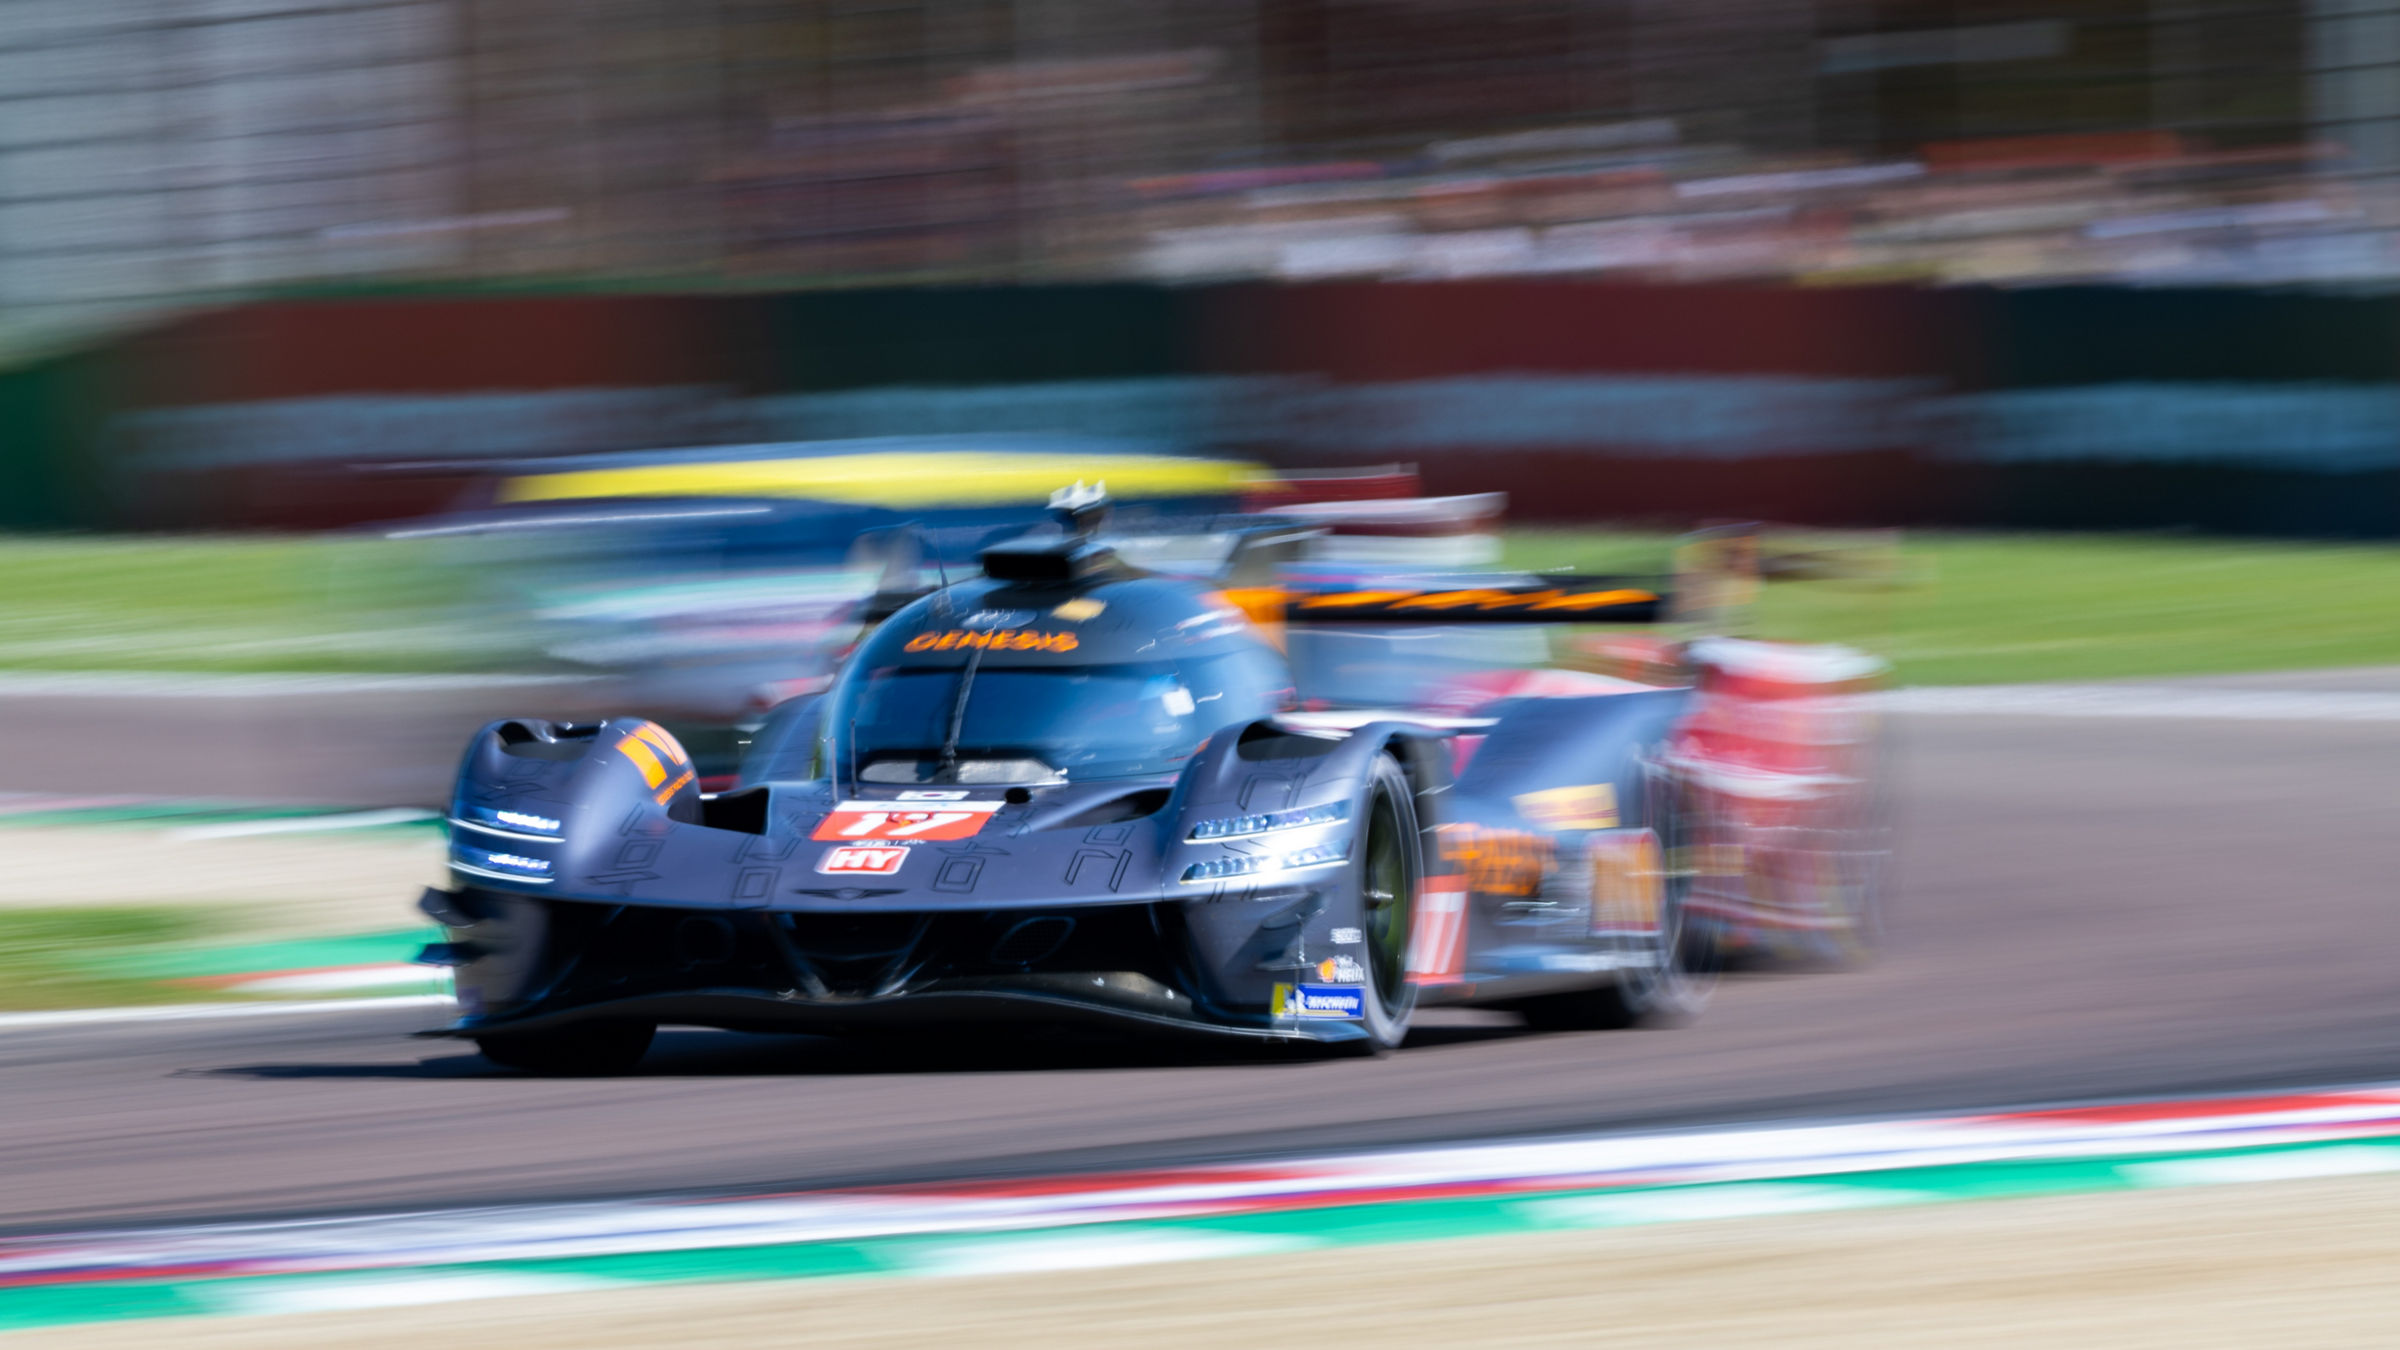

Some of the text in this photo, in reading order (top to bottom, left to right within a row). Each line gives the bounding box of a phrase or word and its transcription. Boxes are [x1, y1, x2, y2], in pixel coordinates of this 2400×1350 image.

[904, 629, 1079, 652] GENESIS
[839, 812, 974, 836] 17
[828, 850, 901, 869] HY
